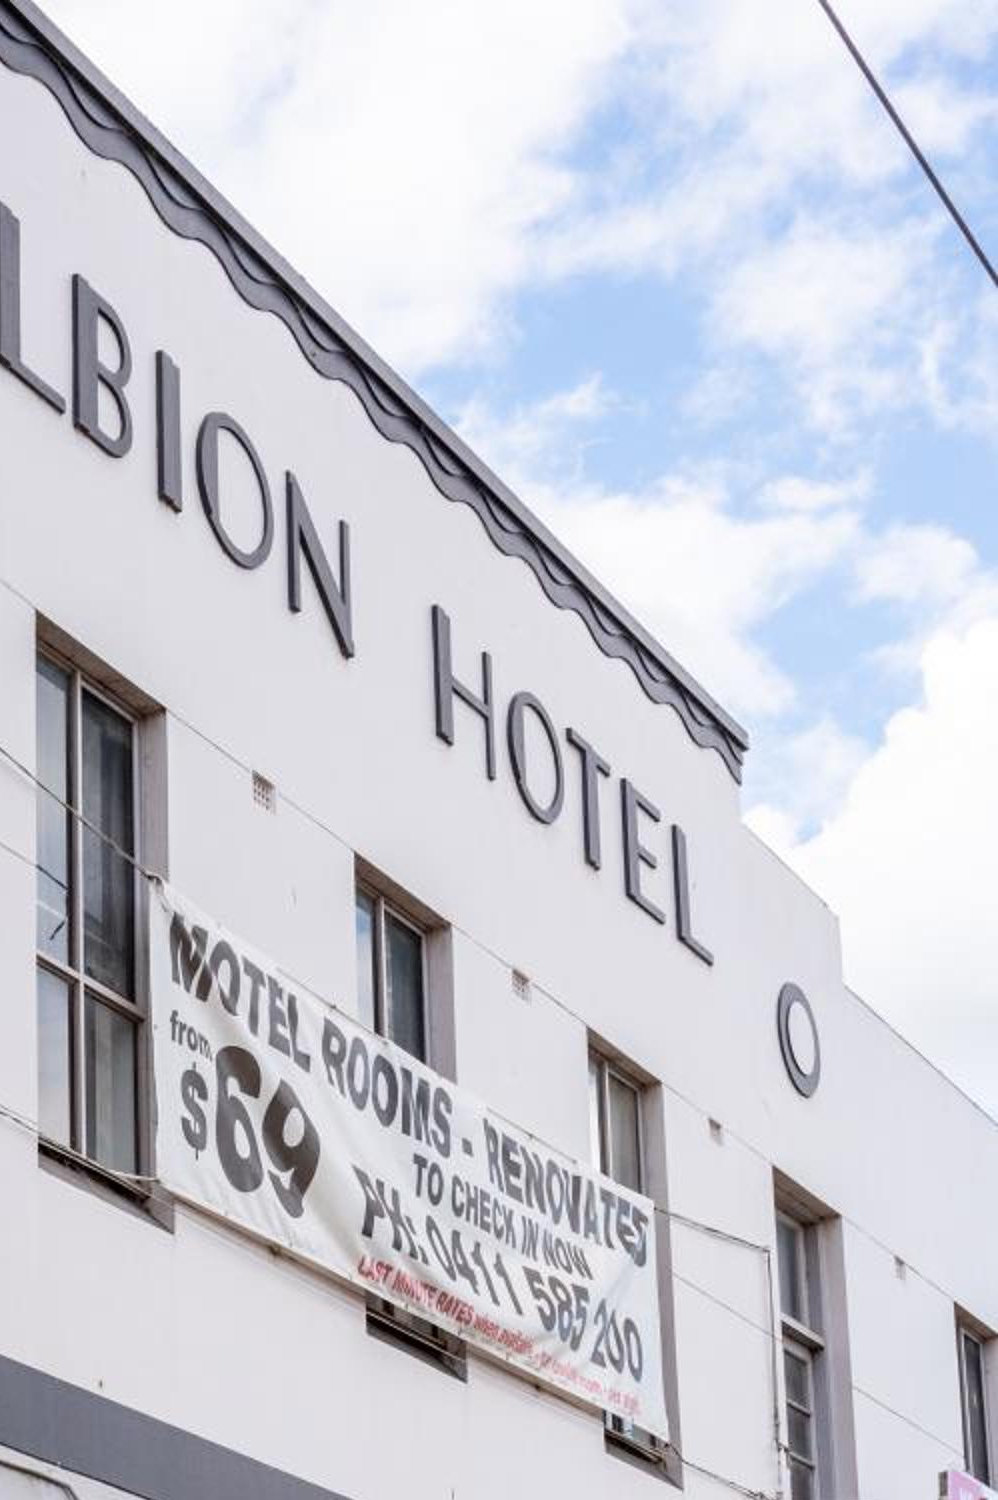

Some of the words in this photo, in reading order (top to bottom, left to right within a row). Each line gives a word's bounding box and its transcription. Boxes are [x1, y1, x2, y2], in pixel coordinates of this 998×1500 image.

[430, 603, 714, 967] HOTEL
[169, 911, 312, 1074] MOTEL
[321, 1016, 454, 1159] ROOMS
[169, 1009, 213, 1062] from
[181, 1044, 321, 1219] $69
[413, 1152, 444, 1206] TO
[451, 1174, 517, 1250] CHECK
[521, 1215, 539, 1262] IN
[543, 1228, 594, 1281] NOW
[357, 1254, 394, 1284] LAST
[435, 1290, 475, 1326] RATES
[425, 1214, 524, 1317] 0411
[521, 1264, 591, 1352] 585
[589, 1297, 644, 1384] 200
